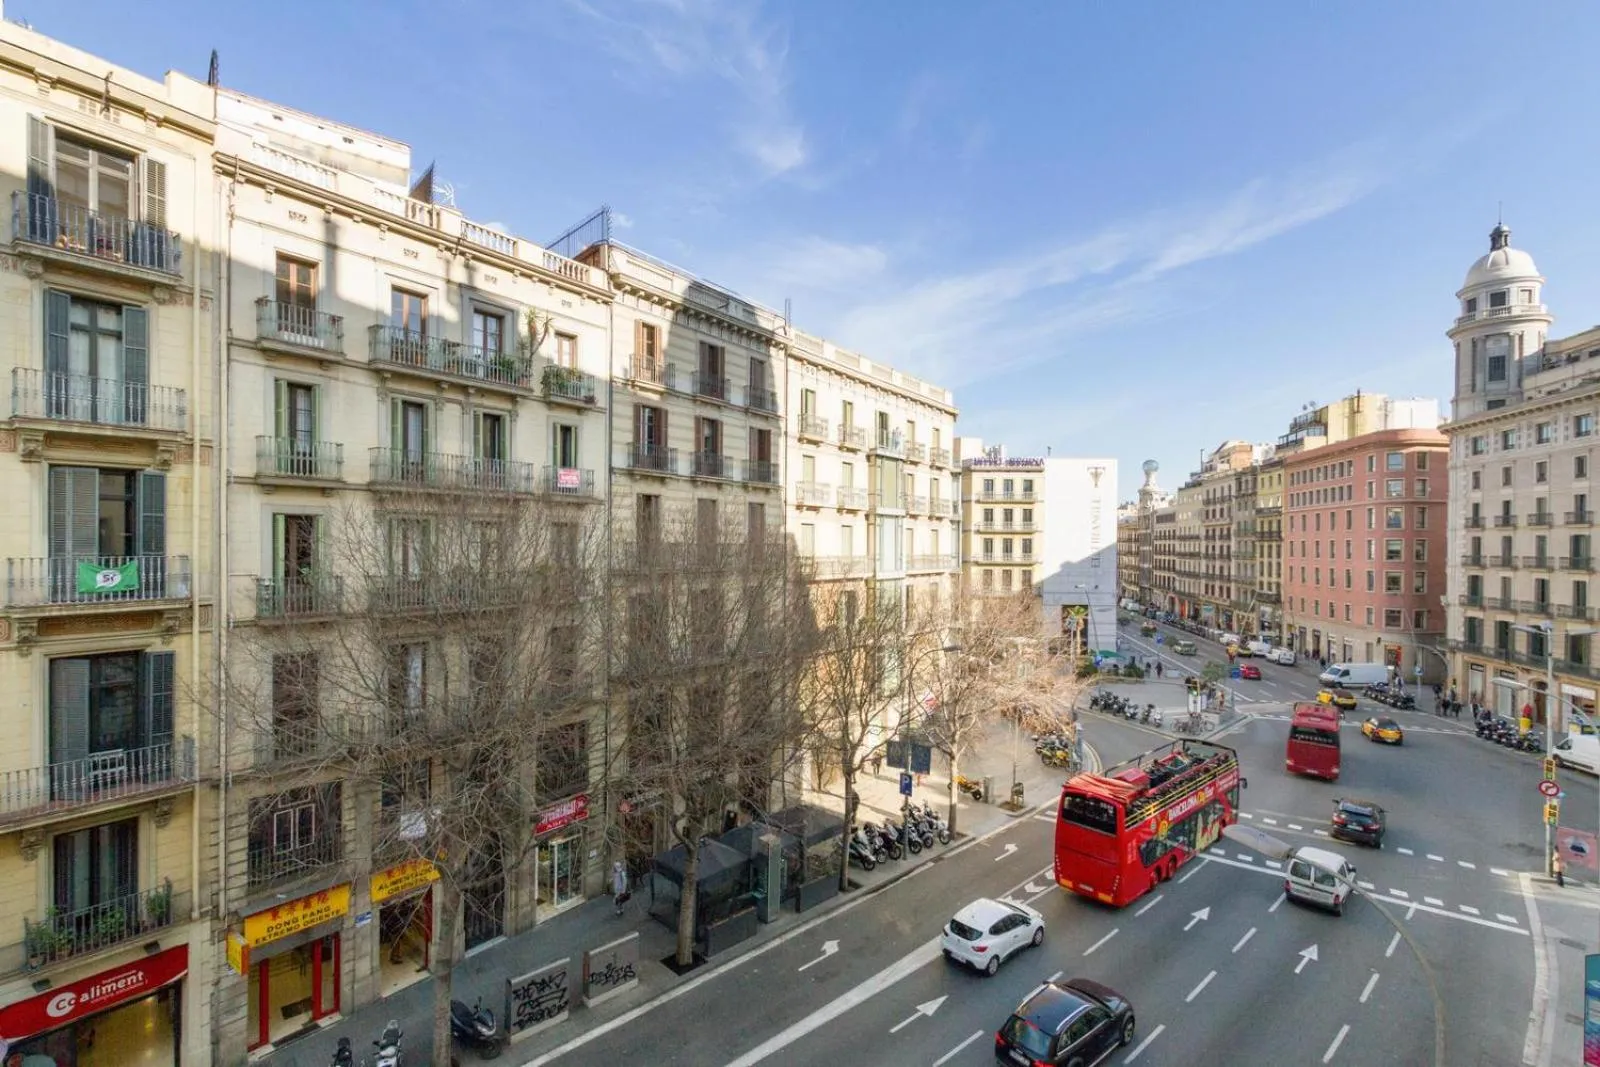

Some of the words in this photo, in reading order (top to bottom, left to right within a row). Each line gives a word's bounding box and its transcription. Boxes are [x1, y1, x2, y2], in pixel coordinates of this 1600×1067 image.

[255, 924, 300, 944] EXTREMO
[303, 909, 341, 925] ORIENTE
[266, 917, 298, 933] DONG
[302, 905, 331, 921] FANG
